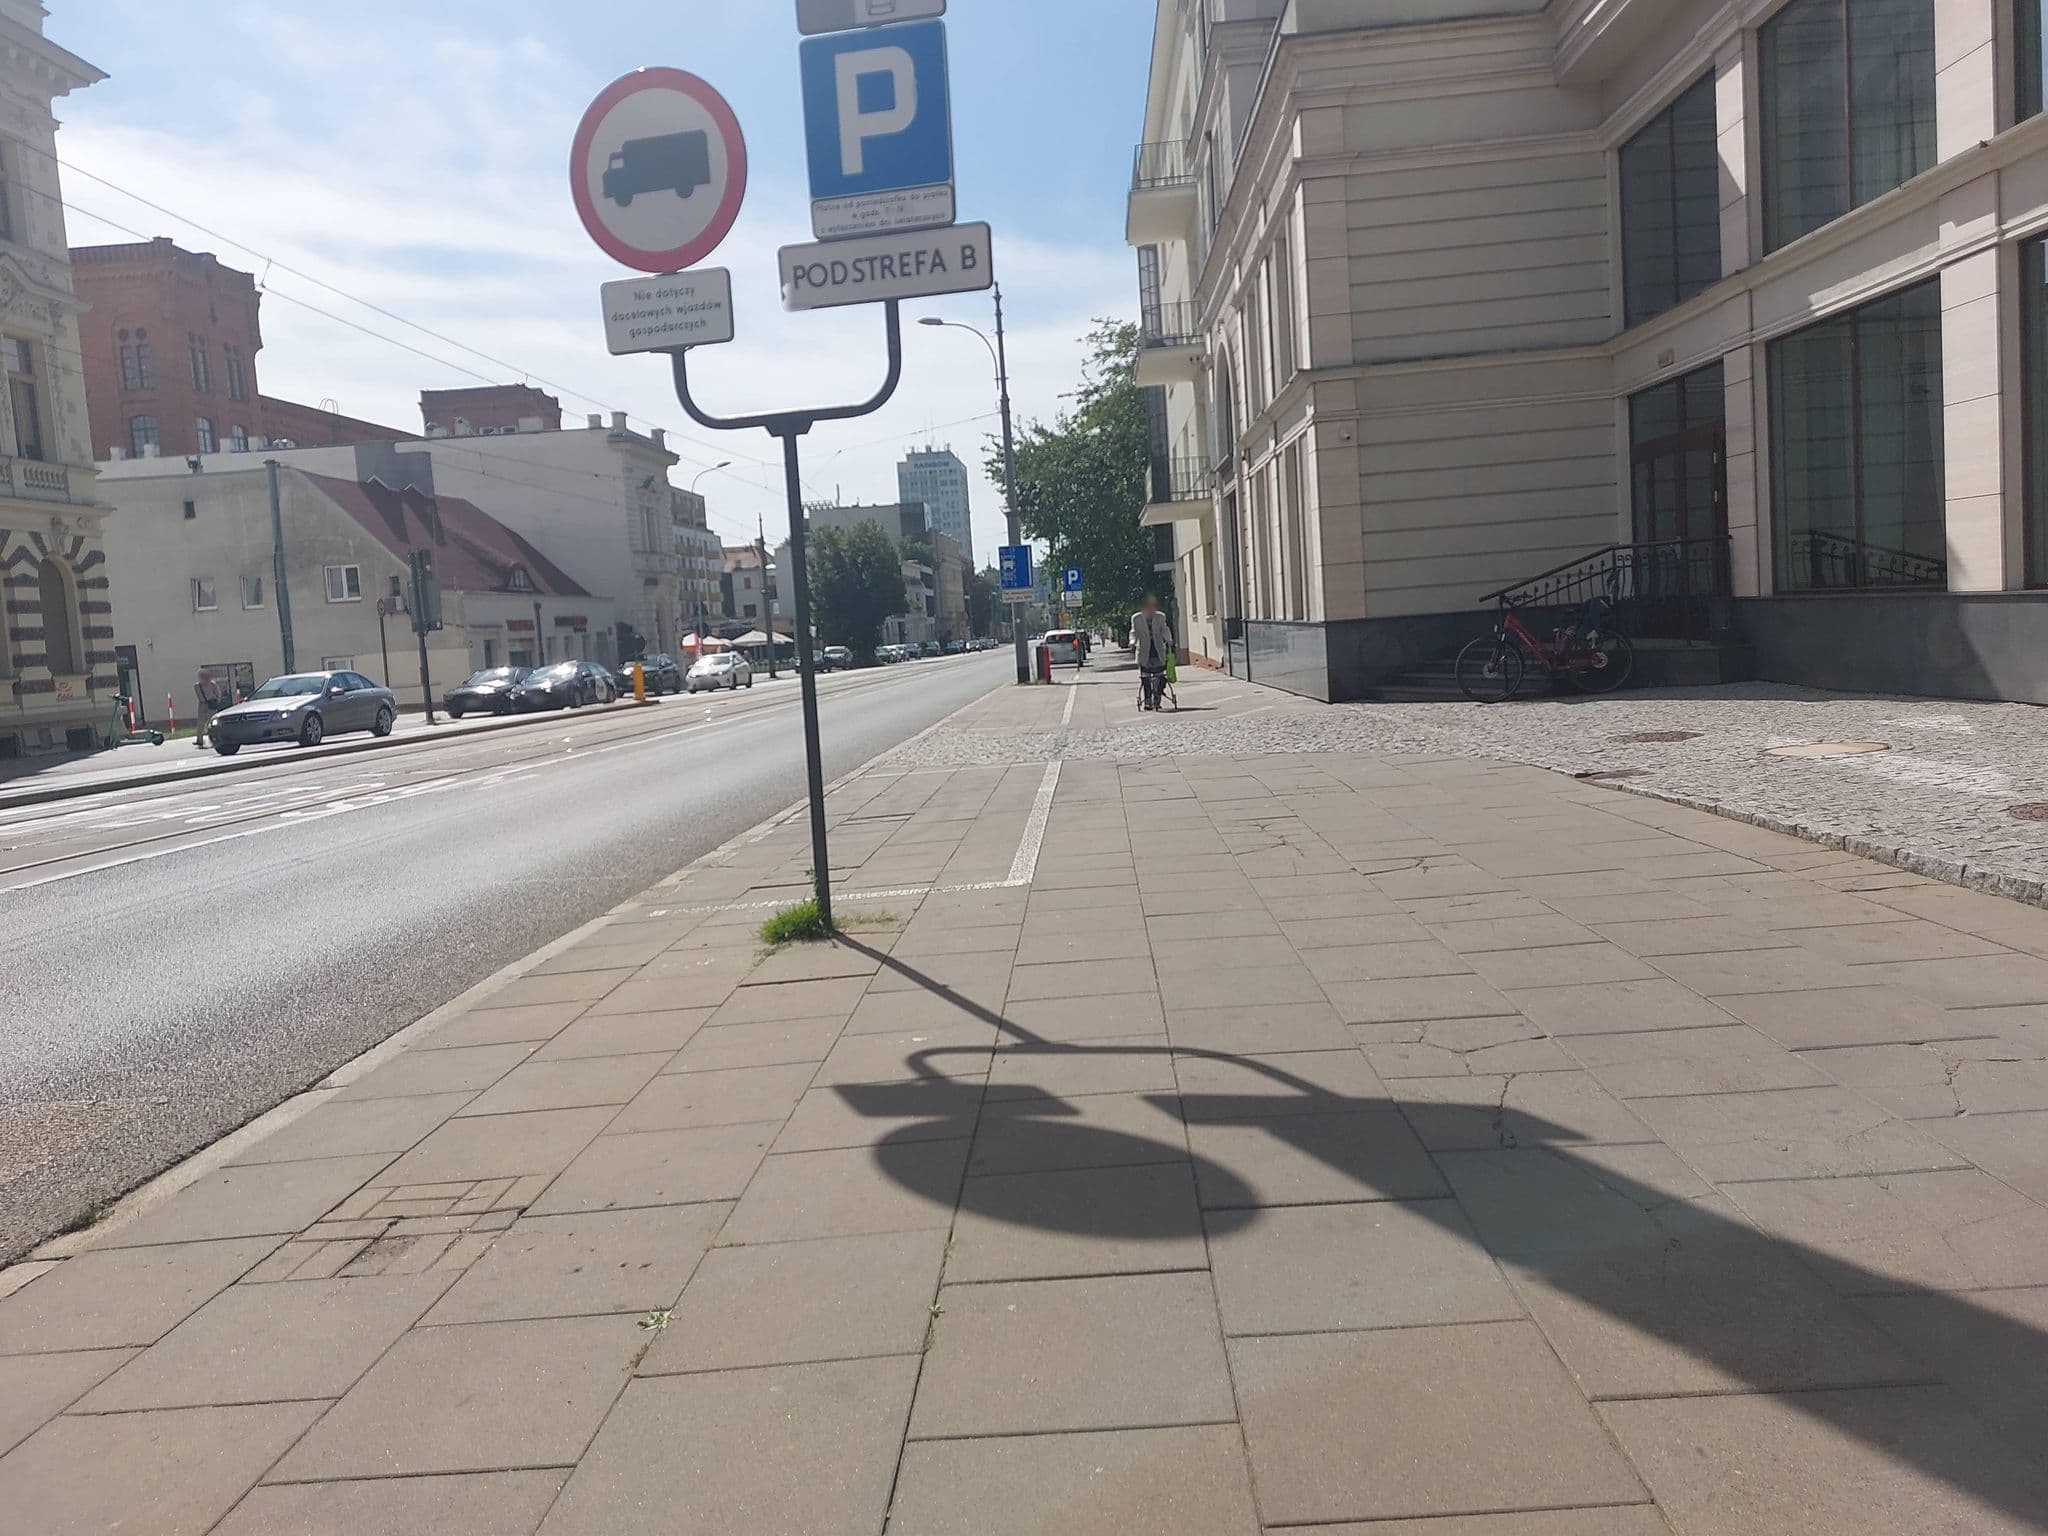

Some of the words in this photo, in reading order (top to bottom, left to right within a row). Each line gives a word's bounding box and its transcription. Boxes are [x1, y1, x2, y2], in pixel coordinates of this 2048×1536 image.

[834, 45, 918, 176] P
[793, 248, 948, 289] PODSTREFA
[960, 244, 977, 270] B
[633, 289, 652, 302] Nie
[655, 287, 695, 299] dotyczy
[611, 306, 672, 322] docelowych
[676, 301, 721, 315] wjazdów
[628, 319, 707, 339] gospodarczych
[1067, 569, 1078, 585] P
